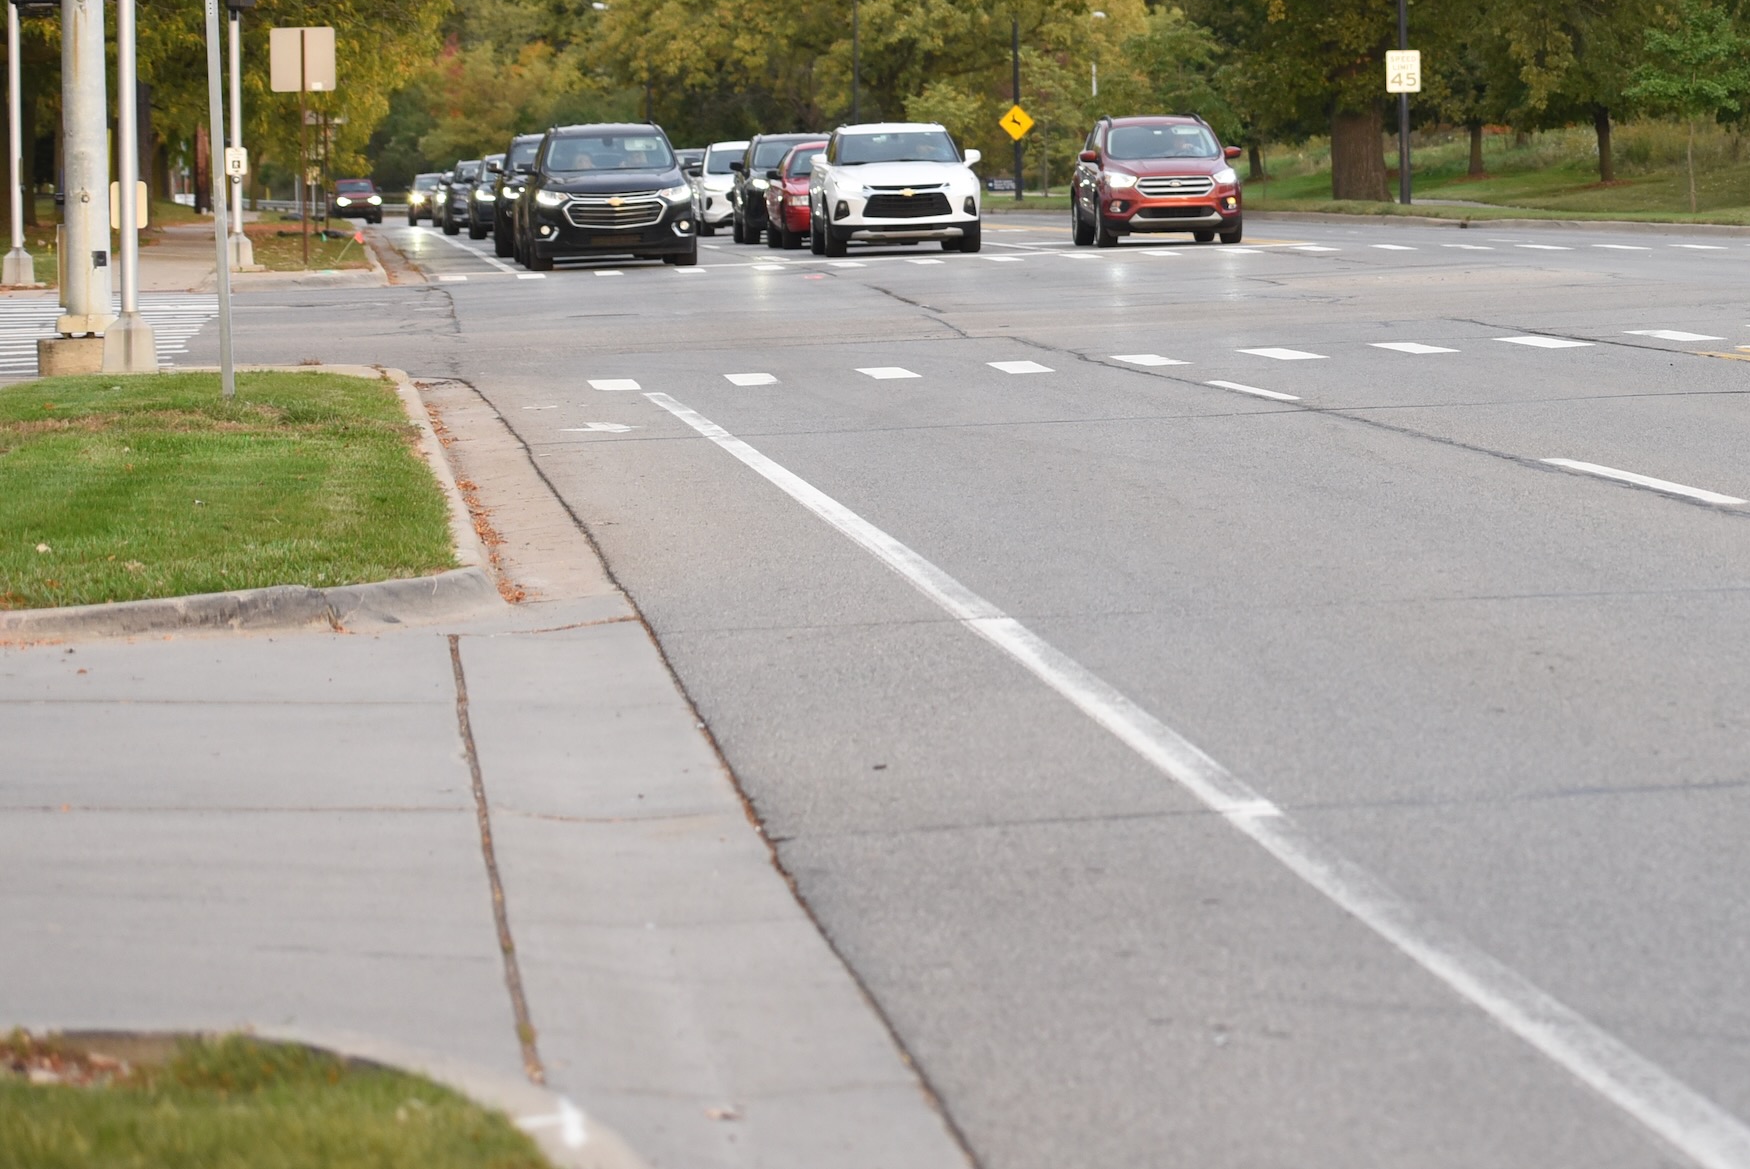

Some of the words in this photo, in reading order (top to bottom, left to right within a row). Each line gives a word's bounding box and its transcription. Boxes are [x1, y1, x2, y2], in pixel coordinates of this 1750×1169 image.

[1390, 55, 1417, 63] SPEED
[1392, 63, 1414, 71] LIMIT
[1390, 72, 1417, 86] 45
